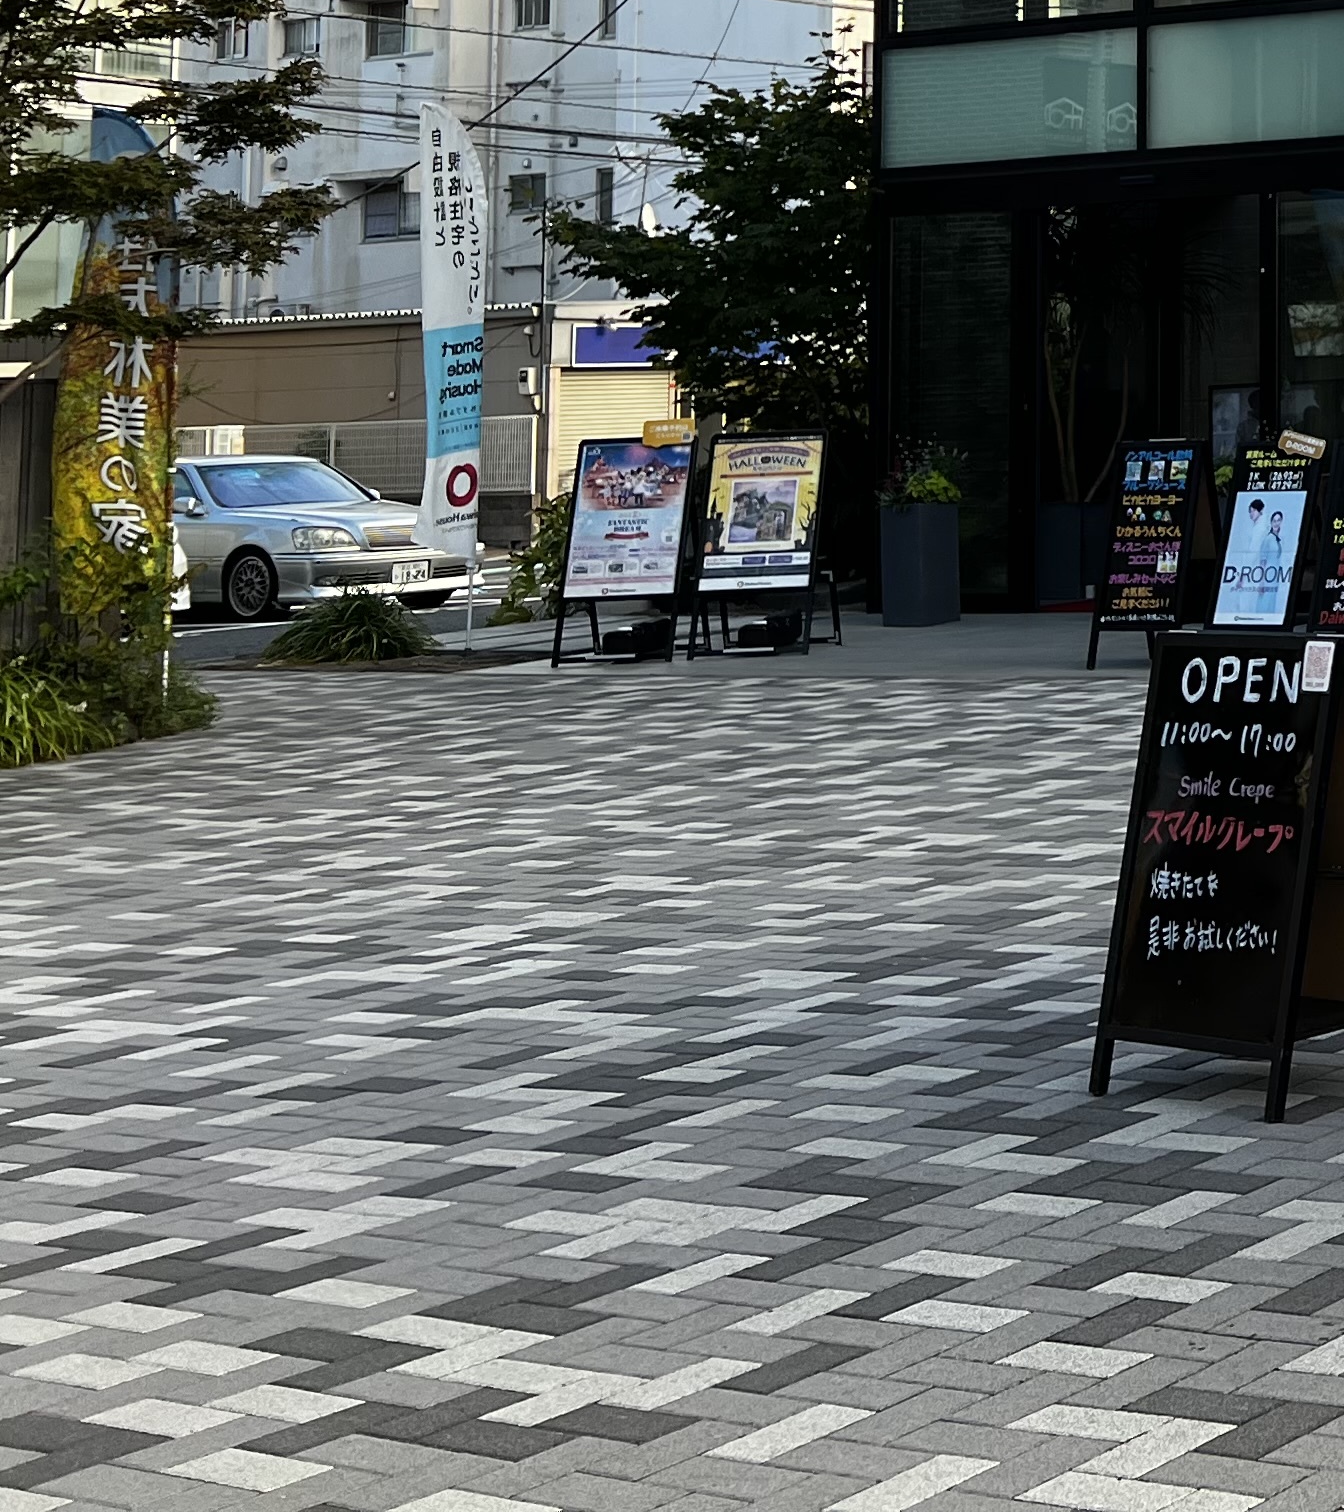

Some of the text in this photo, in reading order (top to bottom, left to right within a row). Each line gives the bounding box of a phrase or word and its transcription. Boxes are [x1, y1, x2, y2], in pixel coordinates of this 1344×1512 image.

[1181, 656, 1303, 705] OPEN
[1177, 770, 1275, 805] Smile Crepe
[1143, 808, 1295, 855] スマイルクレープ
[1150, 860, 1220, 901] 焼きたてを
